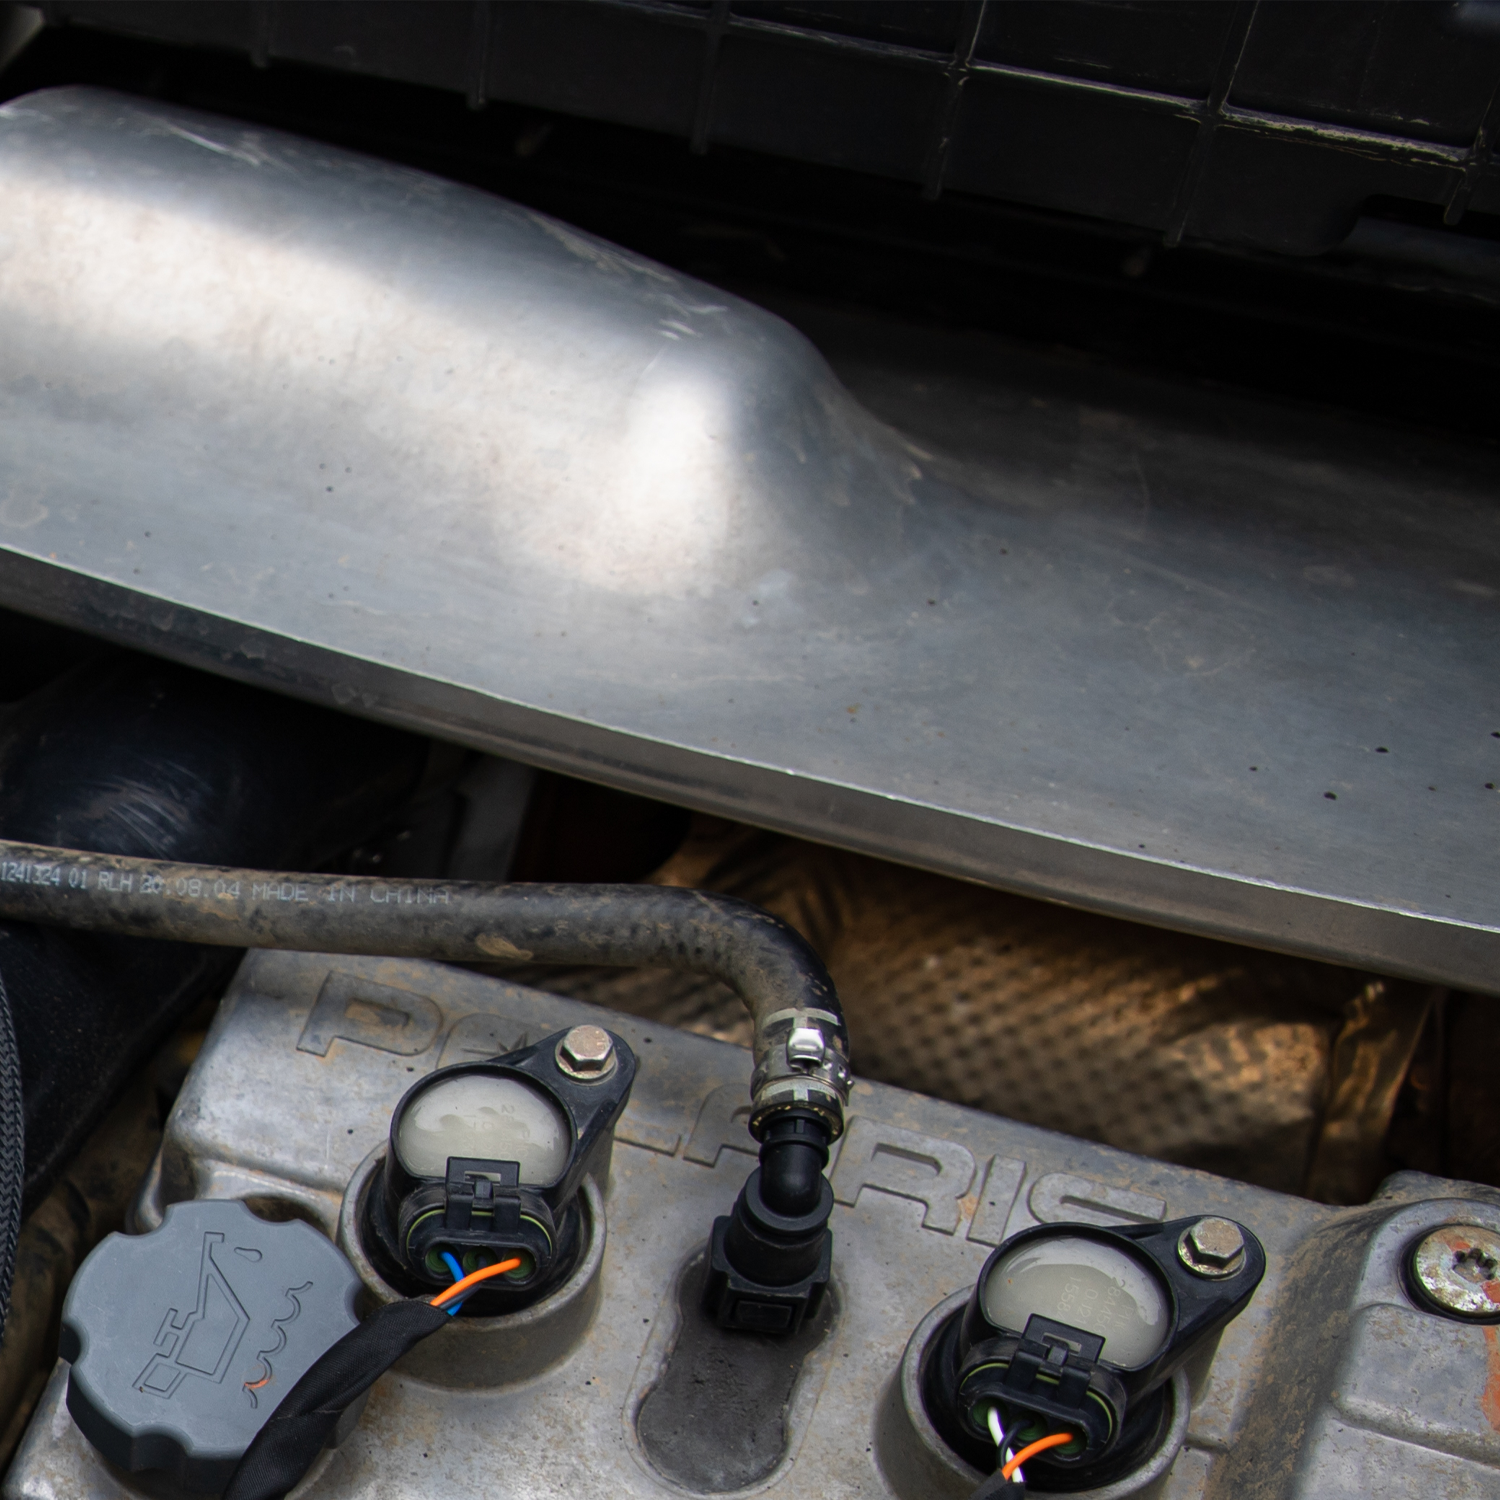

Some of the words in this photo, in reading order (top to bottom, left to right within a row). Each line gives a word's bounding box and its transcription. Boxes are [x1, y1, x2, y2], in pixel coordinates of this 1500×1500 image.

[0, 861, 61, 886] 1241324
[68, 867, 88, 889] 01
[97, 870, 134, 893] RLH
[253, 882, 309, 902] MADE
[327, 884, 356, 902] IN
[370, 886, 450, 905] CHINA
